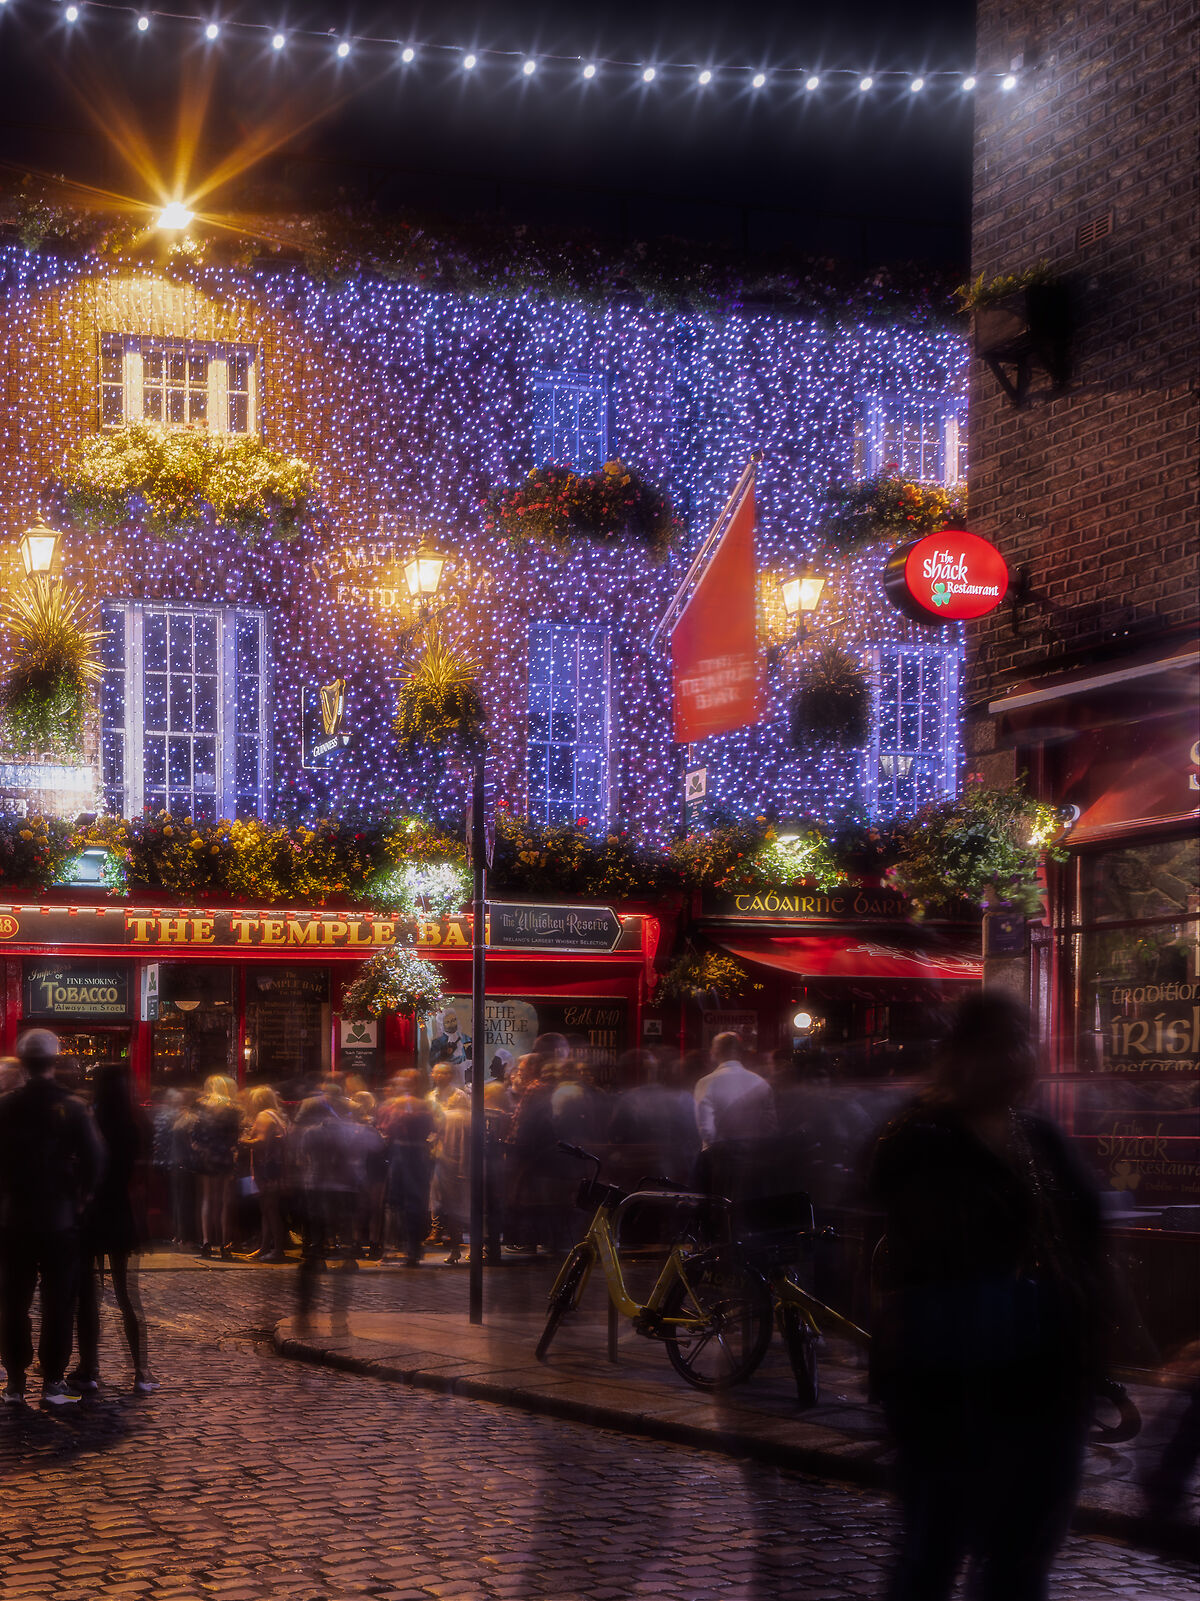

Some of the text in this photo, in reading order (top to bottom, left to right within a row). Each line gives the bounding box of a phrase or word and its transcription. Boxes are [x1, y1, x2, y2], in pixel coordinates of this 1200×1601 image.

[939, 550, 954, 565] The
[923, 550, 968, 584] Shack
[946, 581, 1000, 597] Restaurant
[503, 909, 609, 936] The Whiskey Reserve
[125, 917, 216, 944] THE
[230, 919, 397, 946] TEMPLE
[66, 977, 84, 985] FINE
[84, 977, 118, 985] SMOKING
[40, 981, 118, 1008] TOBACCO
[100, 1004, 125, 1012] Stock
[485, 1006, 515, 1019] THE
[484, 1019, 529, 1033] EMPLE
[486, 1032, 515, 1046] BAR
[1097, 1122, 1170, 1163] Shack
